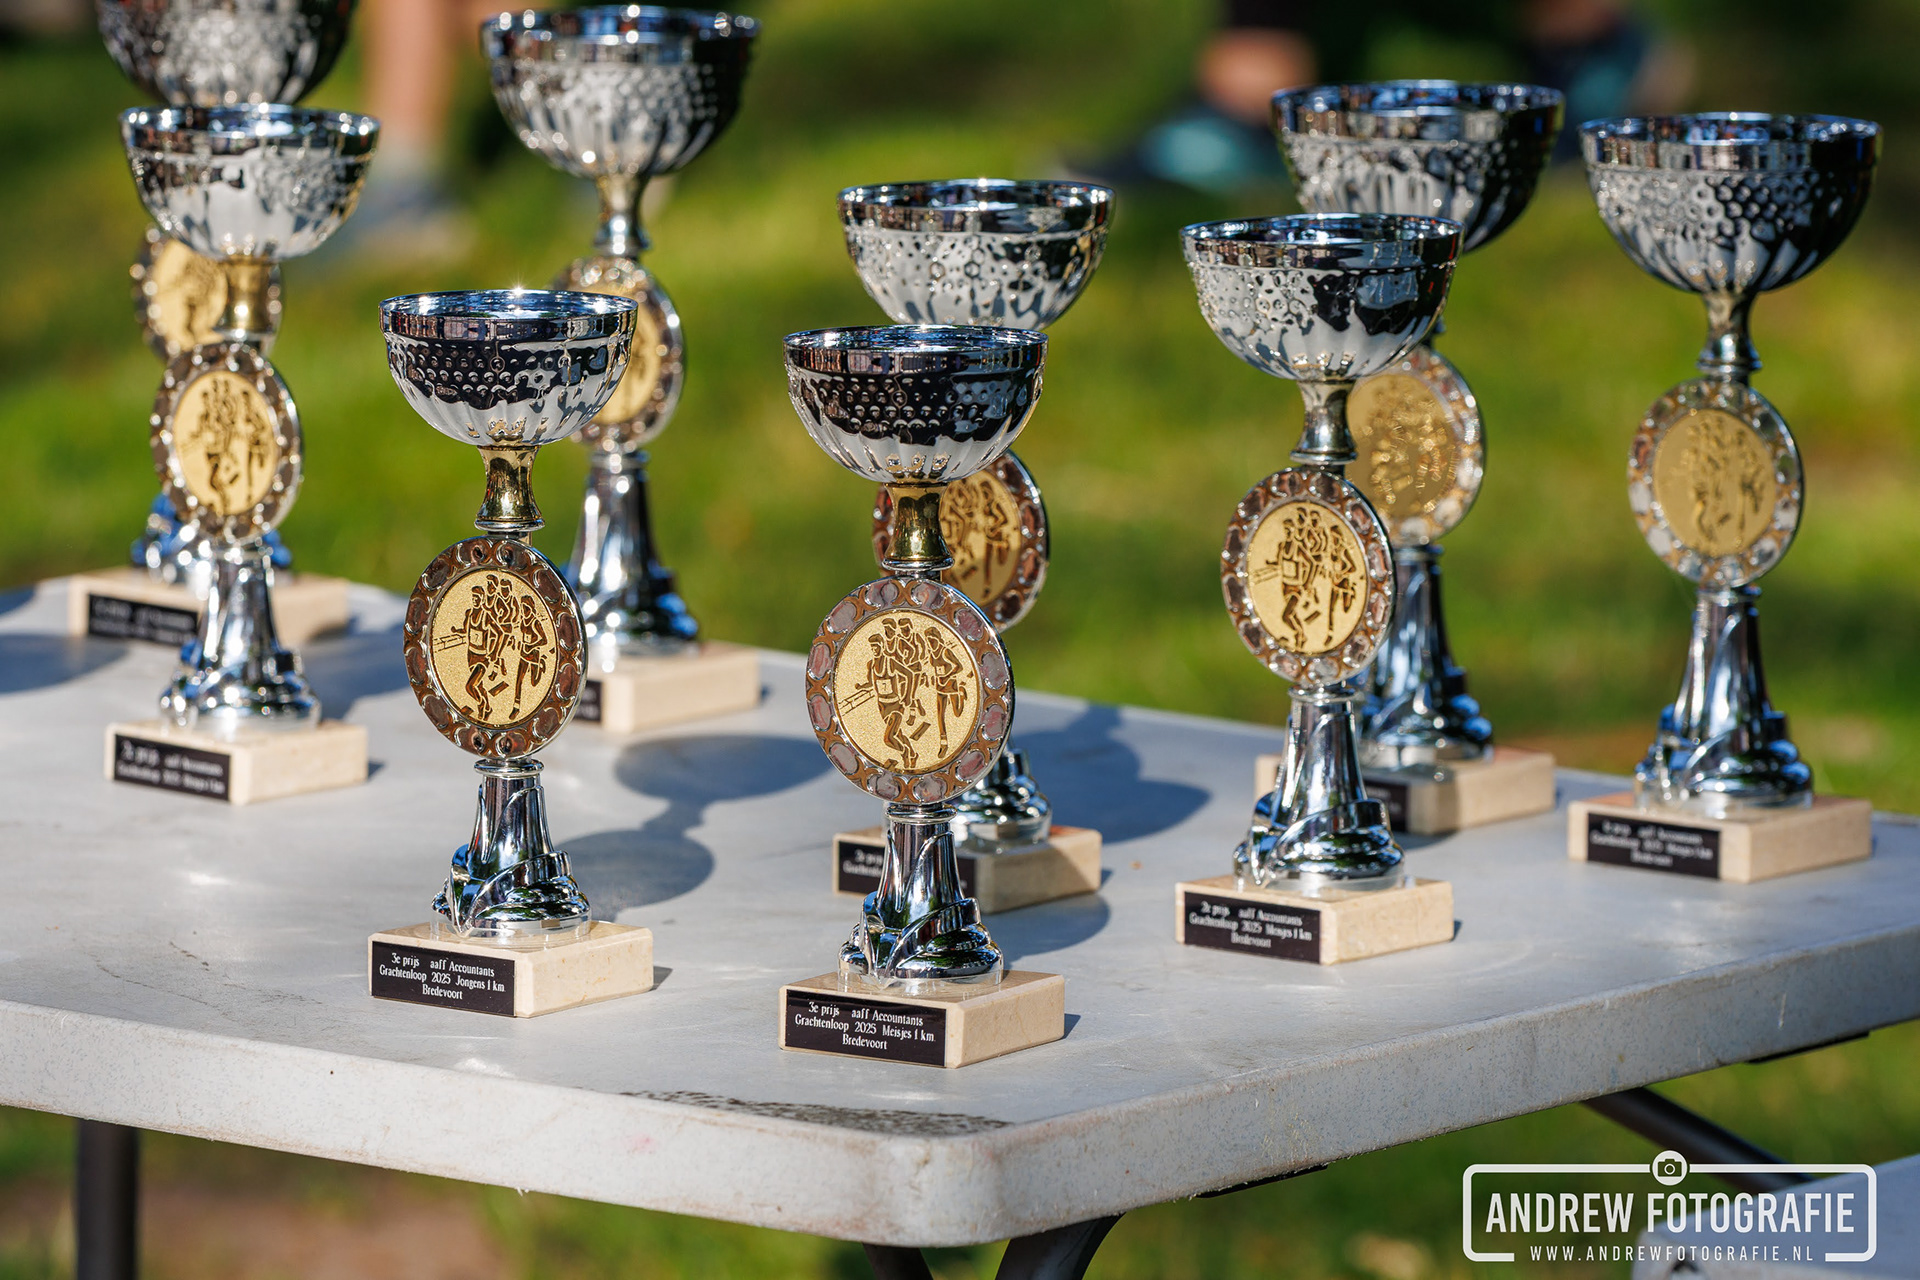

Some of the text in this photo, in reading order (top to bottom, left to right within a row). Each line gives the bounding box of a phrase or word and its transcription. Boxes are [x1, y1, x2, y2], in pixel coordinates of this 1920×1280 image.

[391, 952, 495, 977] 3e prijs aaff Accountants
[379, 965, 427, 983] Grachtenloop
[431, 972, 451, 985] 2025
[455, 975, 485, 990] Jongens
[422, 984, 463, 1000] Bredevoort
[808, 1001, 923, 1026] 3e prijs aaff Accountants
[795, 1014, 849, 1032] Grachtenloop
[854, 1022, 877, 1035] 2025
[882, 1025, 912, 1040] Meisjes
[842, 1034, 888, 1050] Bredevoort
